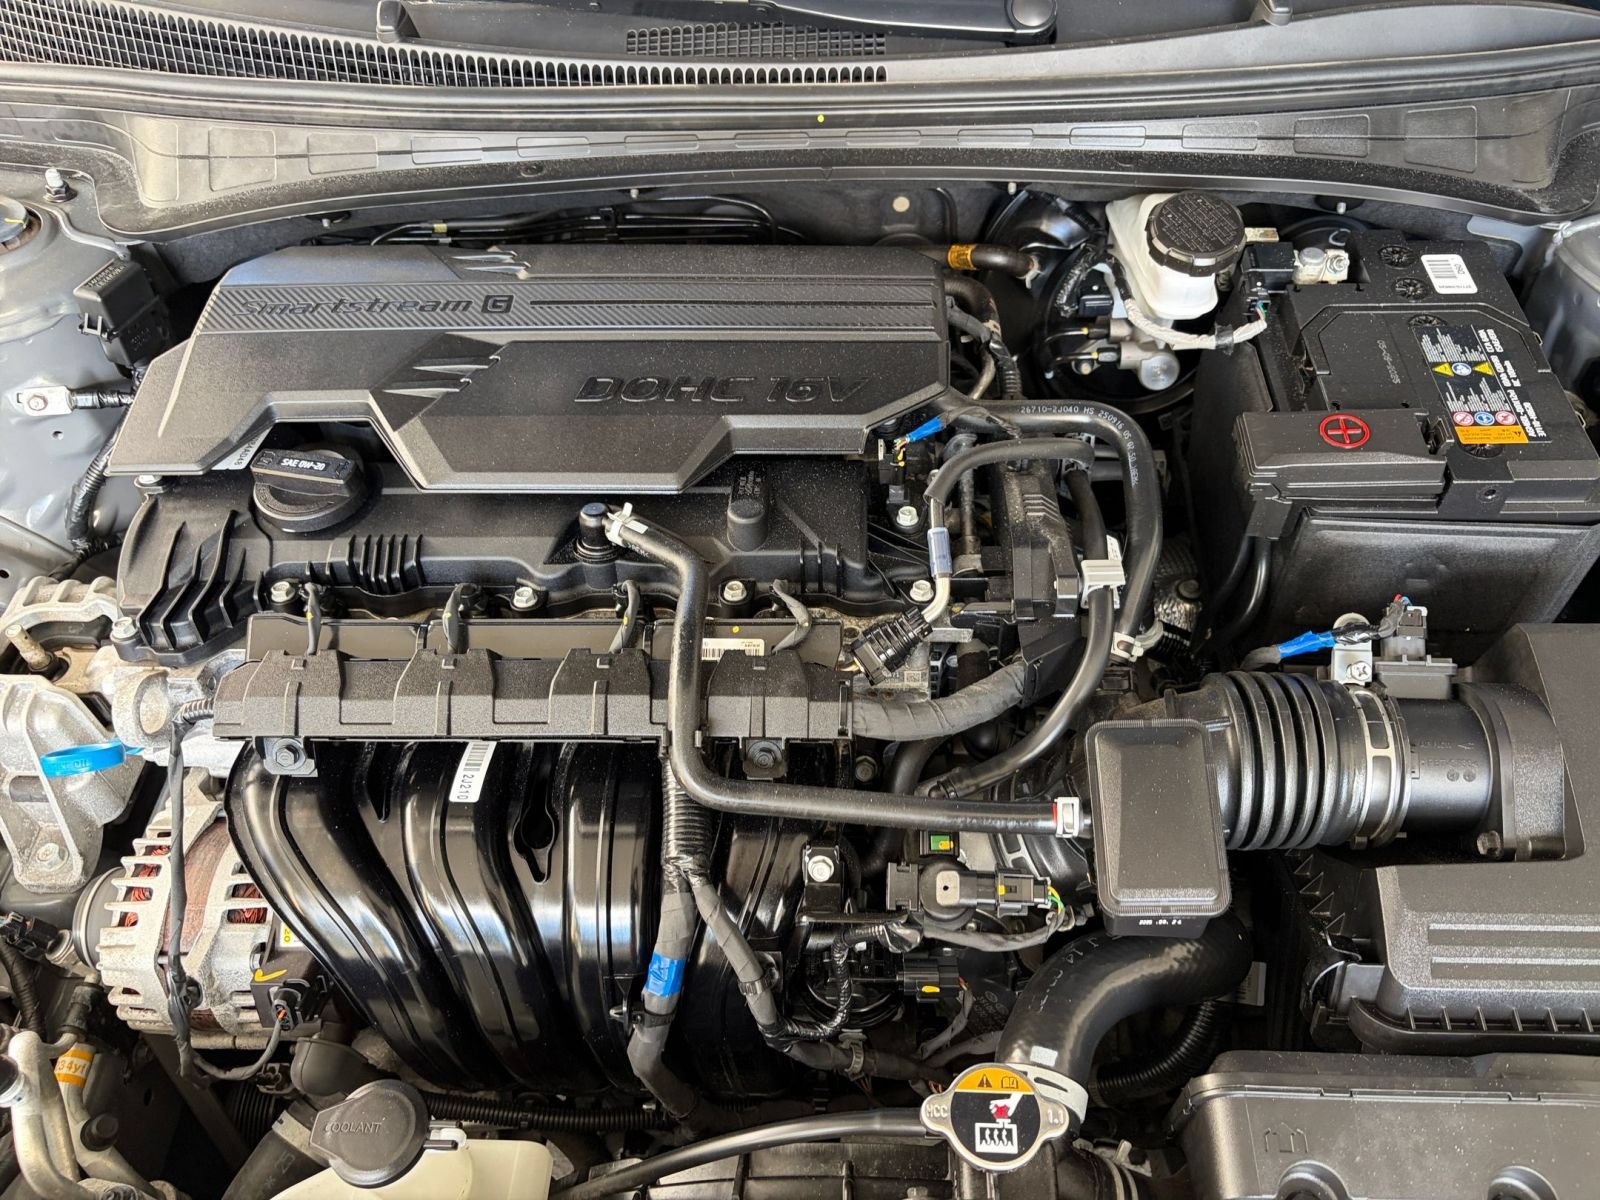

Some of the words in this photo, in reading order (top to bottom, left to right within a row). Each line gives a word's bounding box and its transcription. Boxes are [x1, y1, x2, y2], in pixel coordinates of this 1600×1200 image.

[232, 297, 473, 317] Smartstream
[481, 294, 514, 314] G
[574, 375, 755, 403] DOHC
[767, 375, 871, 403] 16V
[1020, 405, 1079, 414] 26710-2J040
[1083, 406, 1095, 415] HS
[1098, 410, 1126, 430] 250916
[280, 458, 300, 467] SAE
[298, 460, 326, 471] 0W-20
[456, 773, 475, 800] 2J210
[1047, 1108, 1065, 1124] 1.1
[324, 1121, 382, 1135] COOLANT
